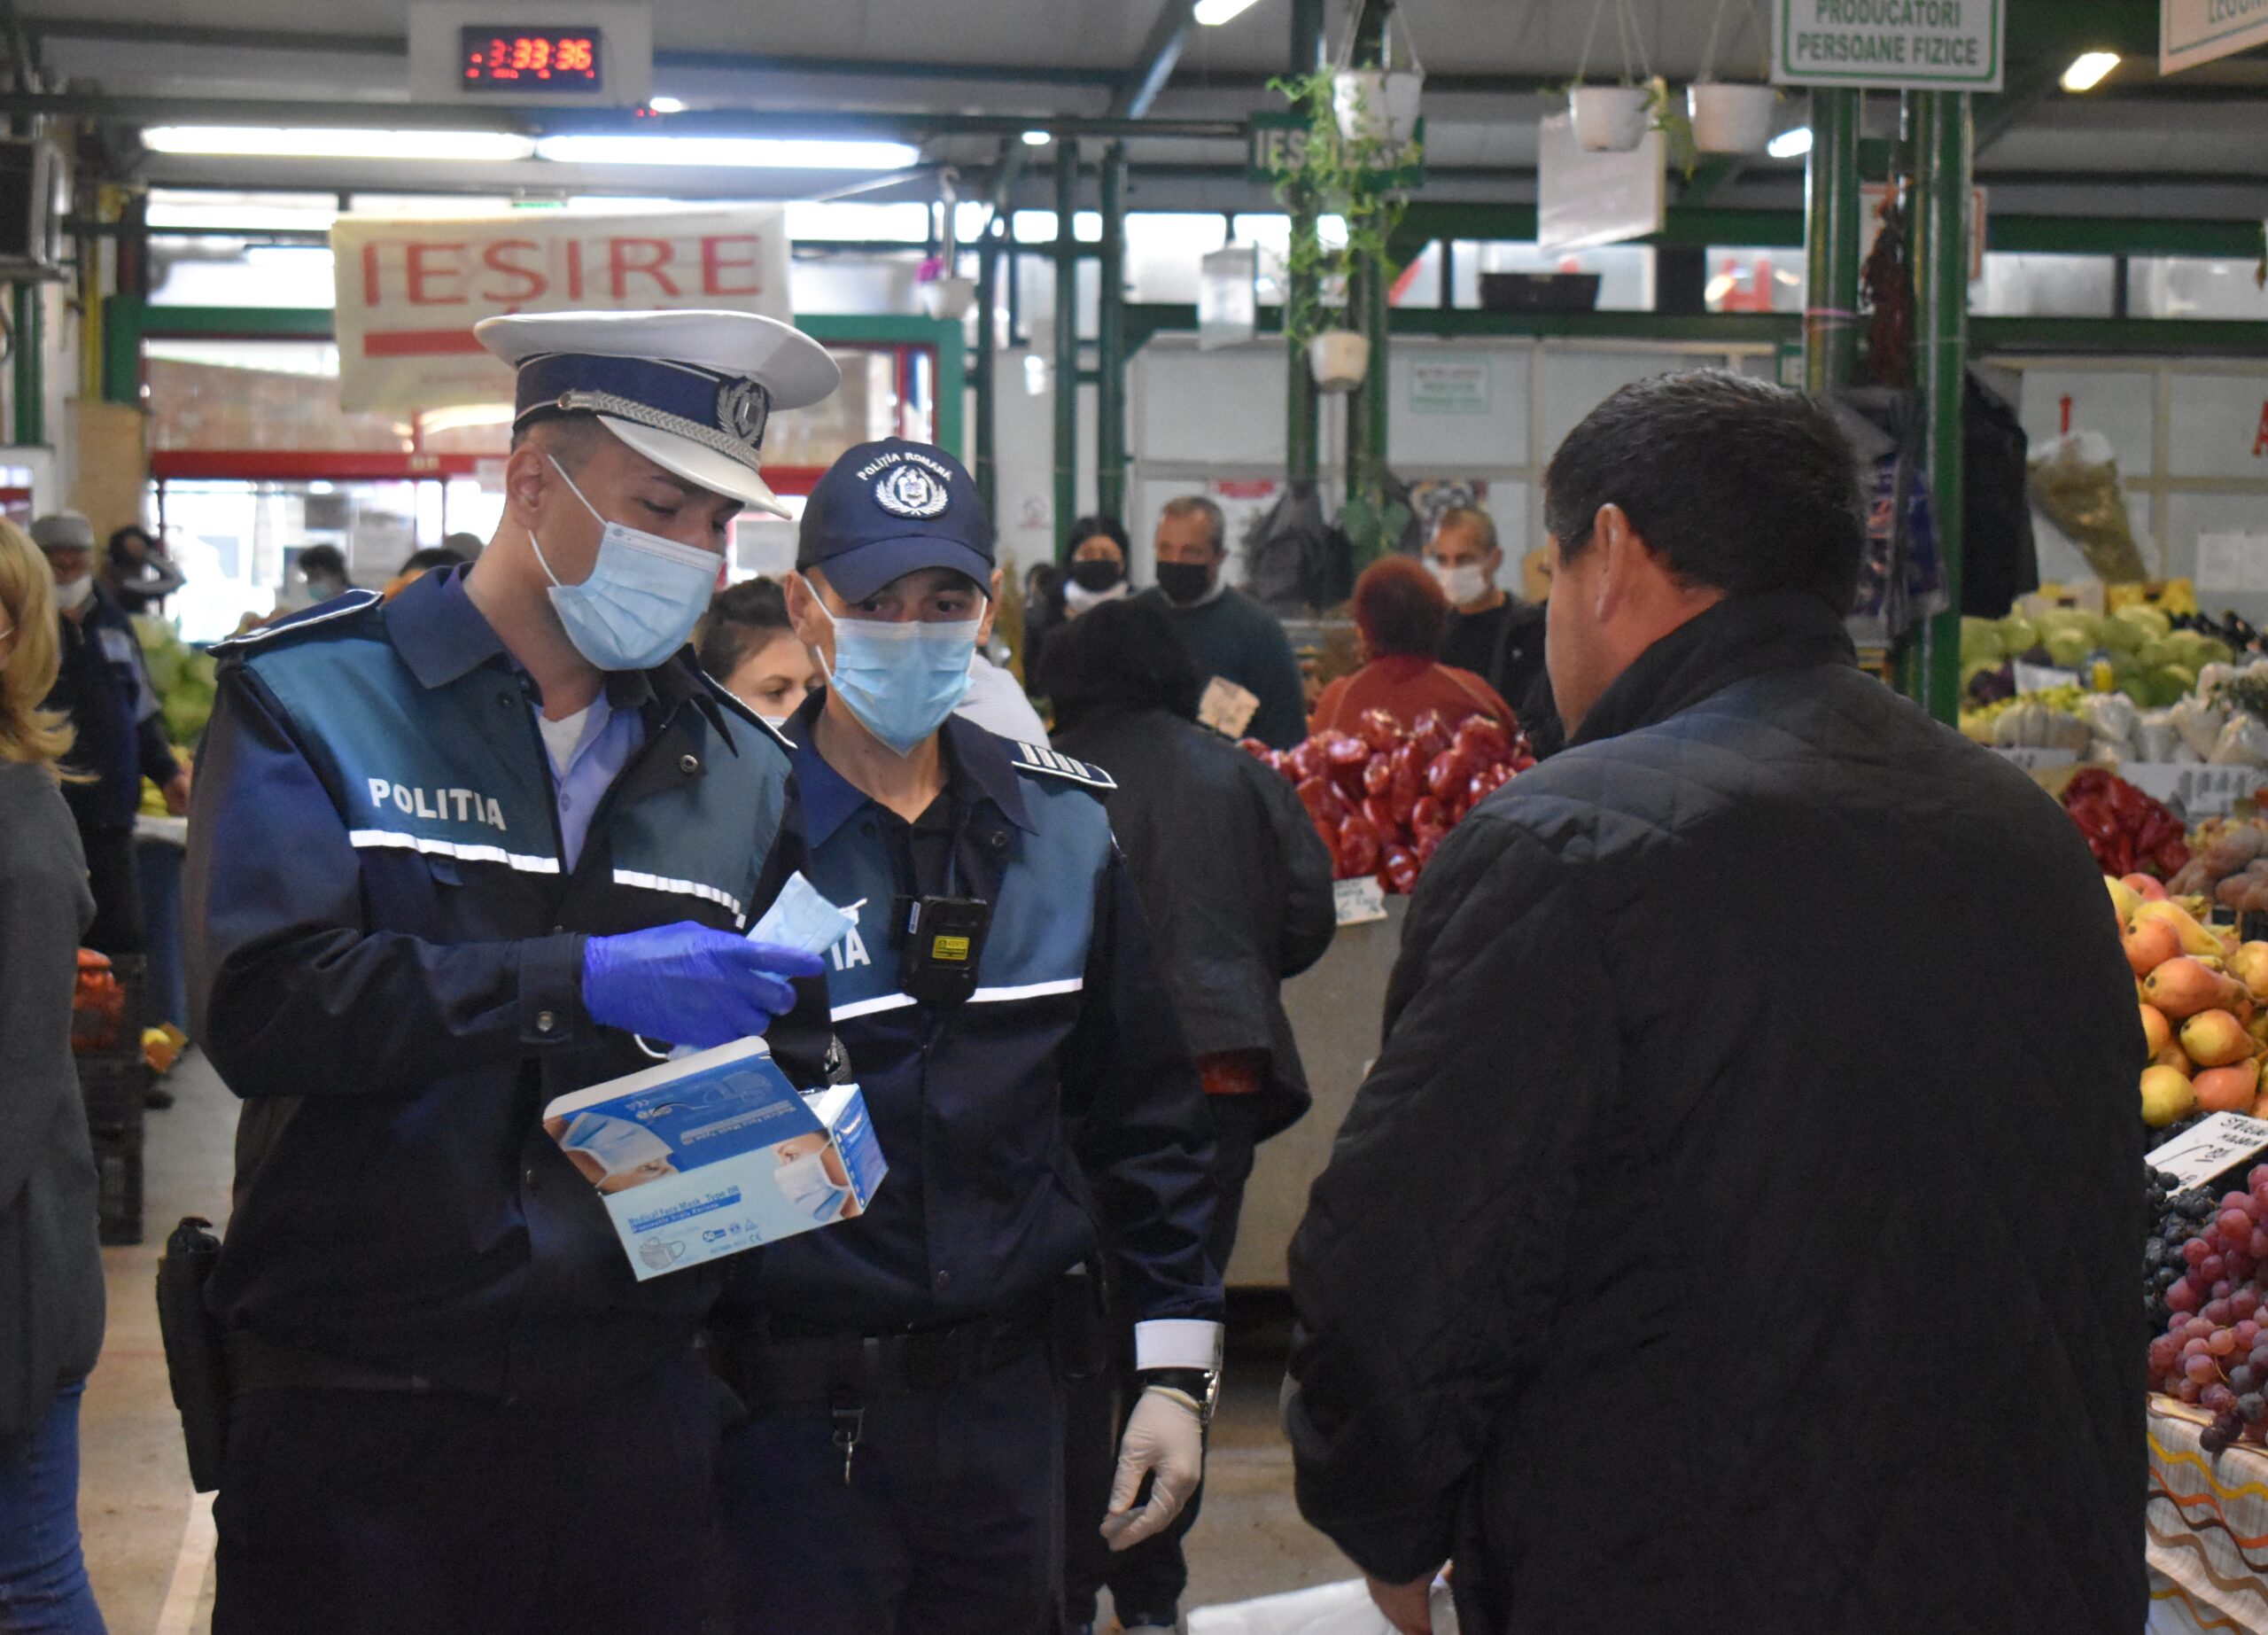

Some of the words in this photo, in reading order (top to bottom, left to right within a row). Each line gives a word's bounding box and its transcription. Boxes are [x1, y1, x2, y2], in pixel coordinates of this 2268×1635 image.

[1797, 33, 1906, 64] PERSOANE
[1912, 36, 1978, 66] FIZICE
[368, 777, 507, 831] POLITIA
